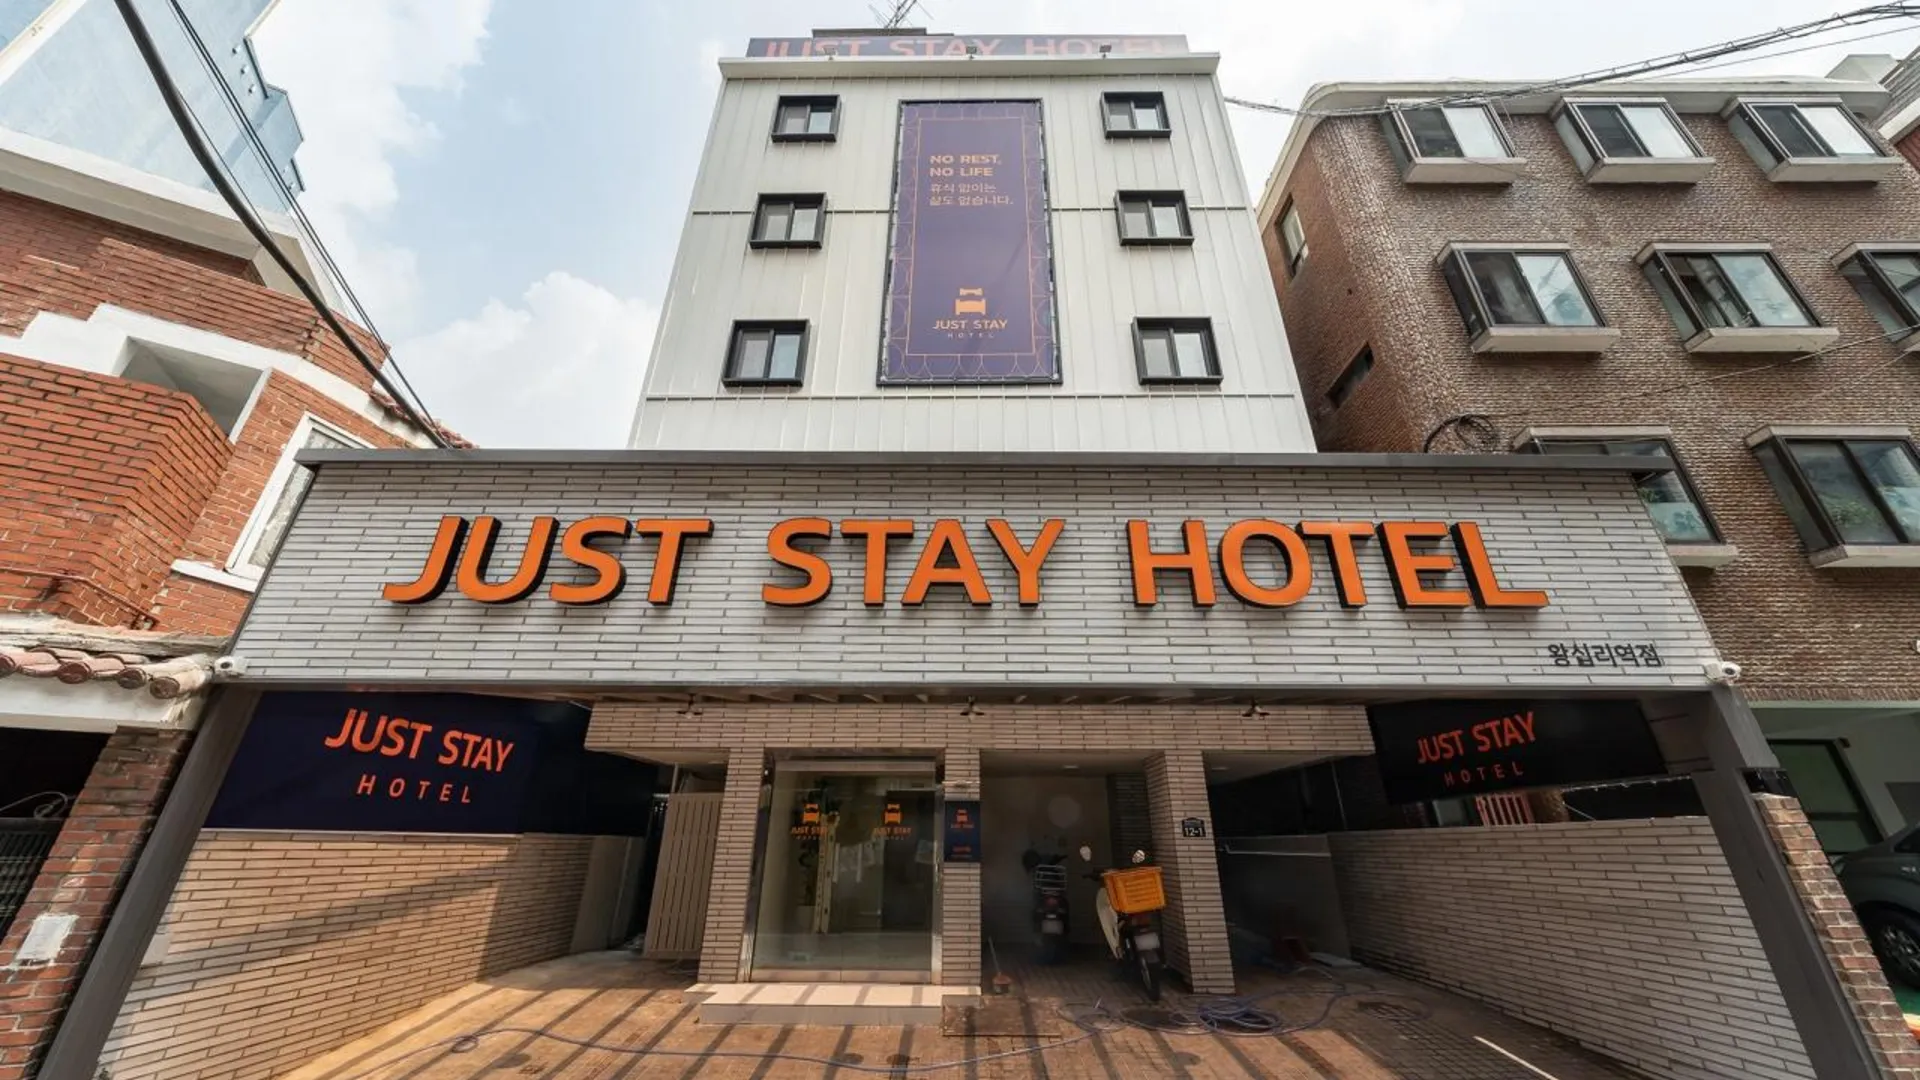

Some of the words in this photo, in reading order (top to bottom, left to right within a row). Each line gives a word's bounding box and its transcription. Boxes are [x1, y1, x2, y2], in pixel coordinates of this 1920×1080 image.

[930, 154, 954, 164] NO
[960, 154, 1002, 165] REST.
[930, 167, 954, 177] NO
[960, 167, 994, 177] LIFE
[931, 183, 955, 194] 휴식
[958, 183, 997, 193] 없이는
[930, 195, 954, 206] 삶도
[958, 195, 1014, 206] 없습니다.
[932, 319, 968, 330] JUST
[973, 319, 1008, 330] STAY
[382, 516, 715, 605] JUST
[762, 517, 1066, 606] STAY
[1126, 519, 1550, 608] HOTEL
[1547, 643, 1664, 667] 왕십리역점
[324, 708, 433, 759] JUST
[438, 730, 515, 772] STAY
[1416, 730, 1465, 765] JUST
[1470, 711, 1537, 753] STAY
[1444, 761, 1524, 788] HOTEL
[356, 774, 471, 803] HOTEL
[1184, 827, 1203, 837] 12-1
